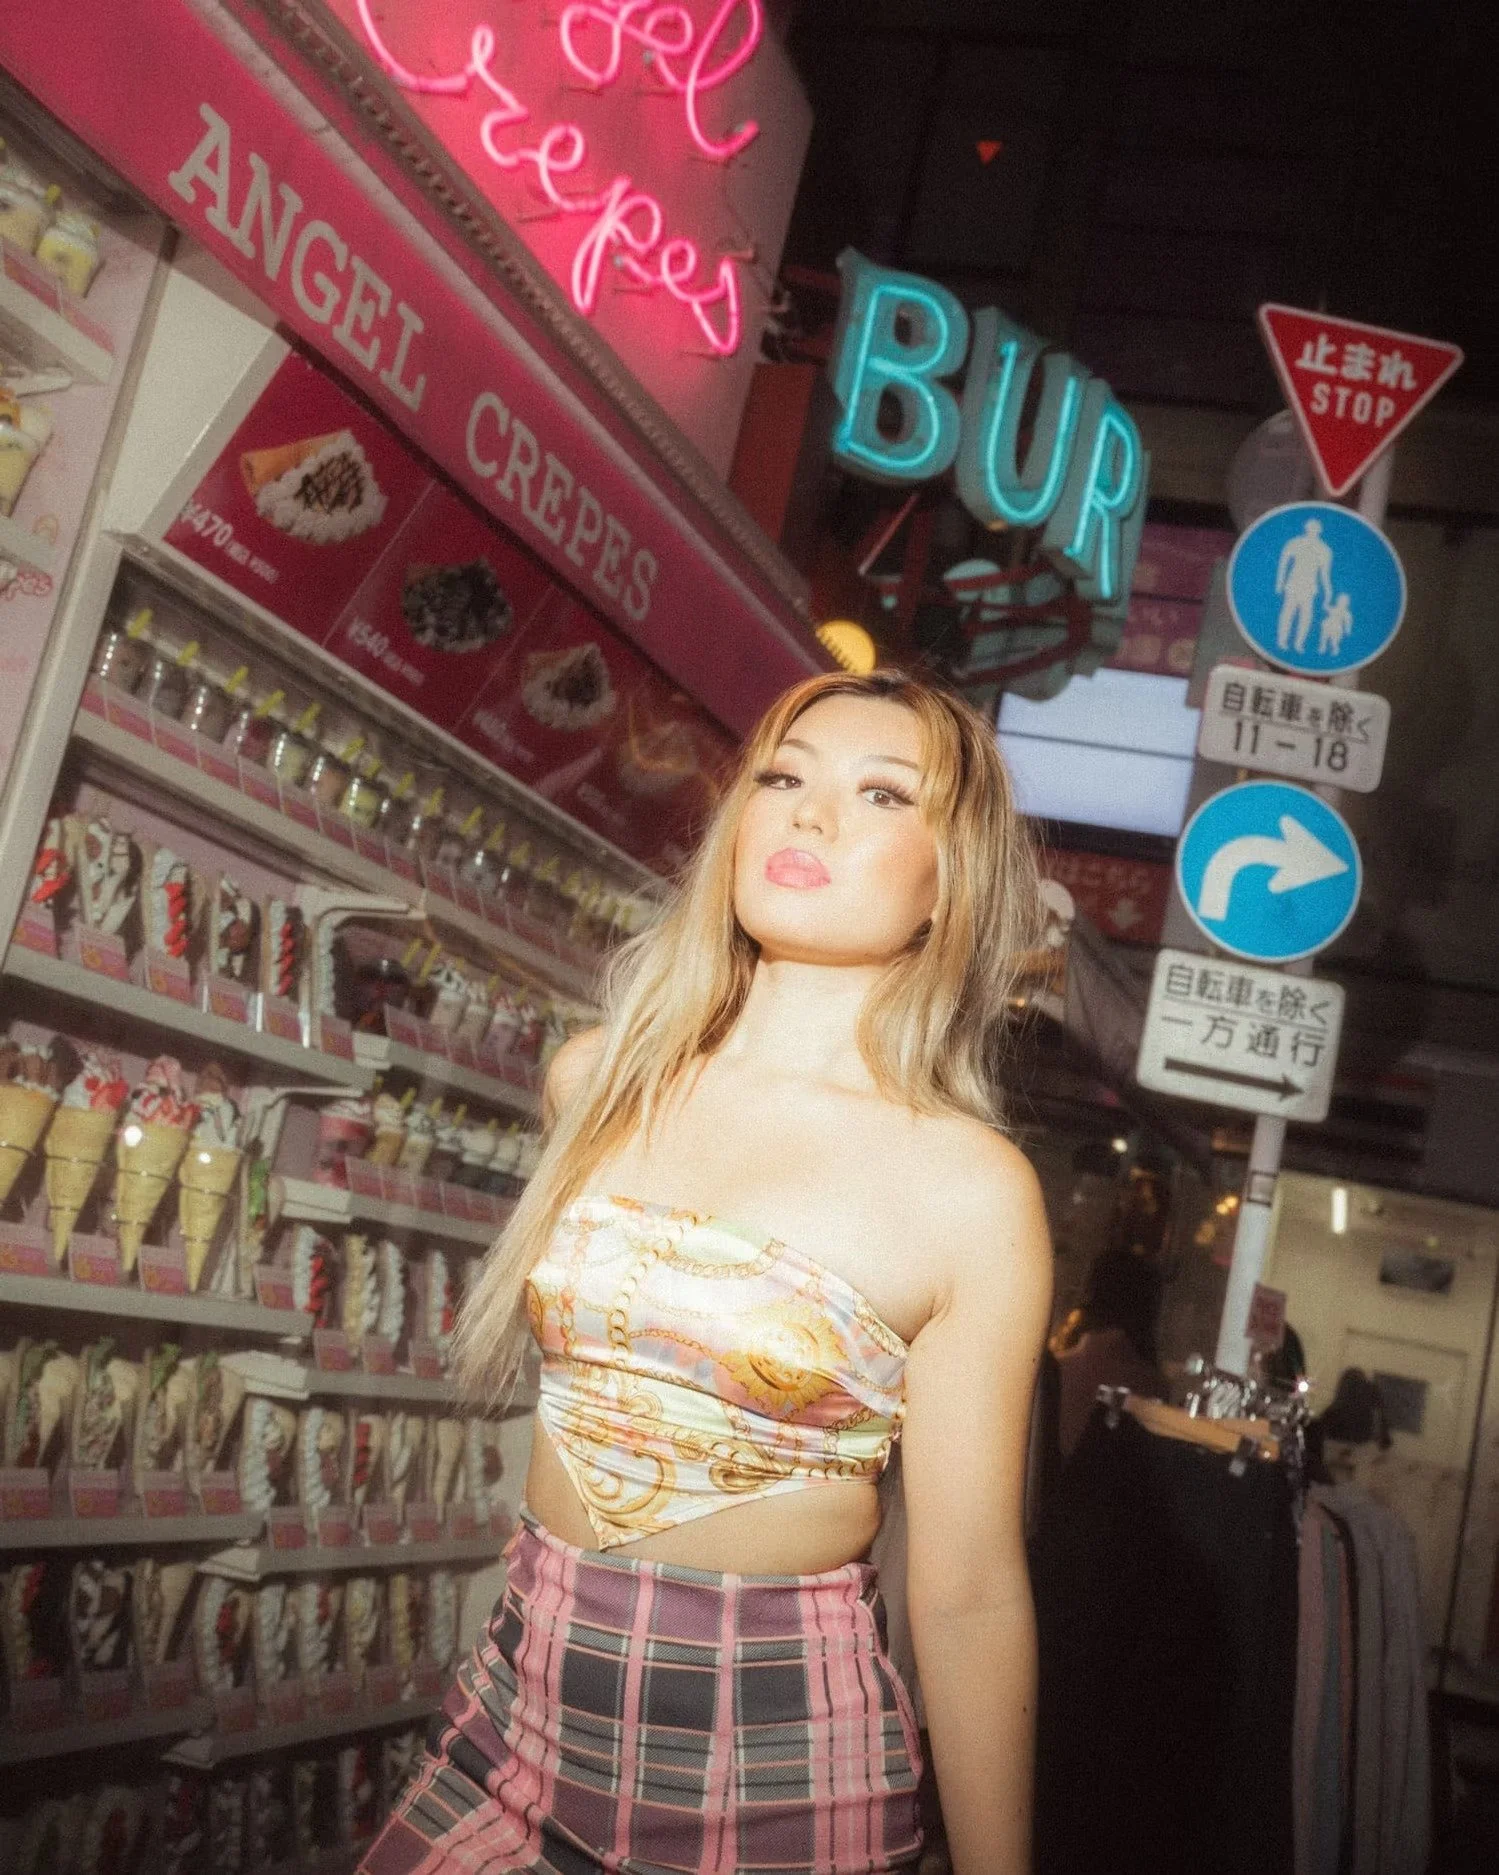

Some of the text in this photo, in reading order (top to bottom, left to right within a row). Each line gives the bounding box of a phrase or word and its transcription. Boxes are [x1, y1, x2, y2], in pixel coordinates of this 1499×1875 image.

[167, 103, 658, 621] ANGEL CREPES
[1294, 333, 1417, 391] 止まれ
[834, 262, 1148, 604] BUR
[1309, 383, 1395, 427] STOP
[1222, 682, 1375, 741] 自転車を除く
[1166, 963, 1330, 1026] 自転車を除く
[1161, 1015, 1327, 1067] 一方通行
